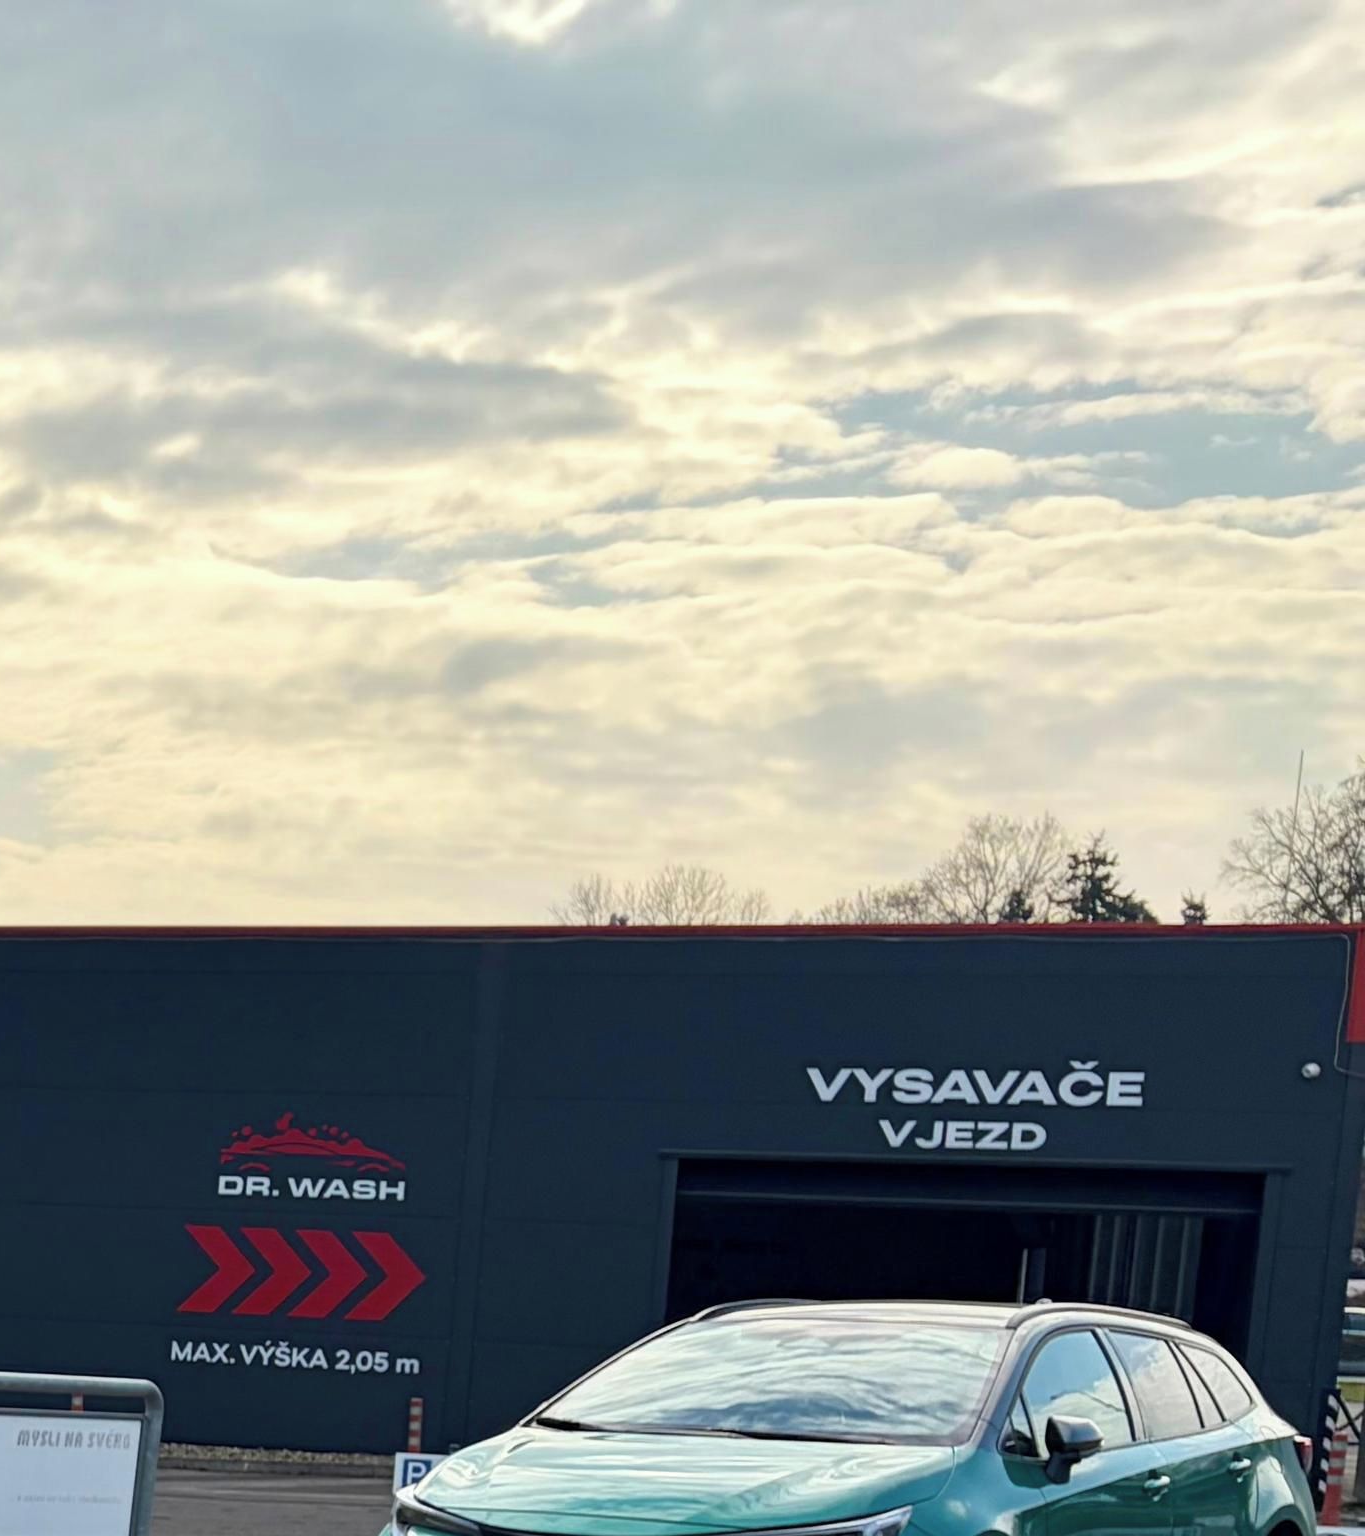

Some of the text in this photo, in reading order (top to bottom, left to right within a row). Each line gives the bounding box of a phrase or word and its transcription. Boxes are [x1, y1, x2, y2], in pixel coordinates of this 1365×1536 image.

[806, 1060, 1145, 1107] VYSAVAČE
[878, 1120, 1047, 1151] VJEZD
[218, 1175, 406, 1201] DR. WASH
[170, 1340, 421, 1375] MAX. VÝŠKA 2,05 m
[17, 1429, 61, 1448] MYSLI
